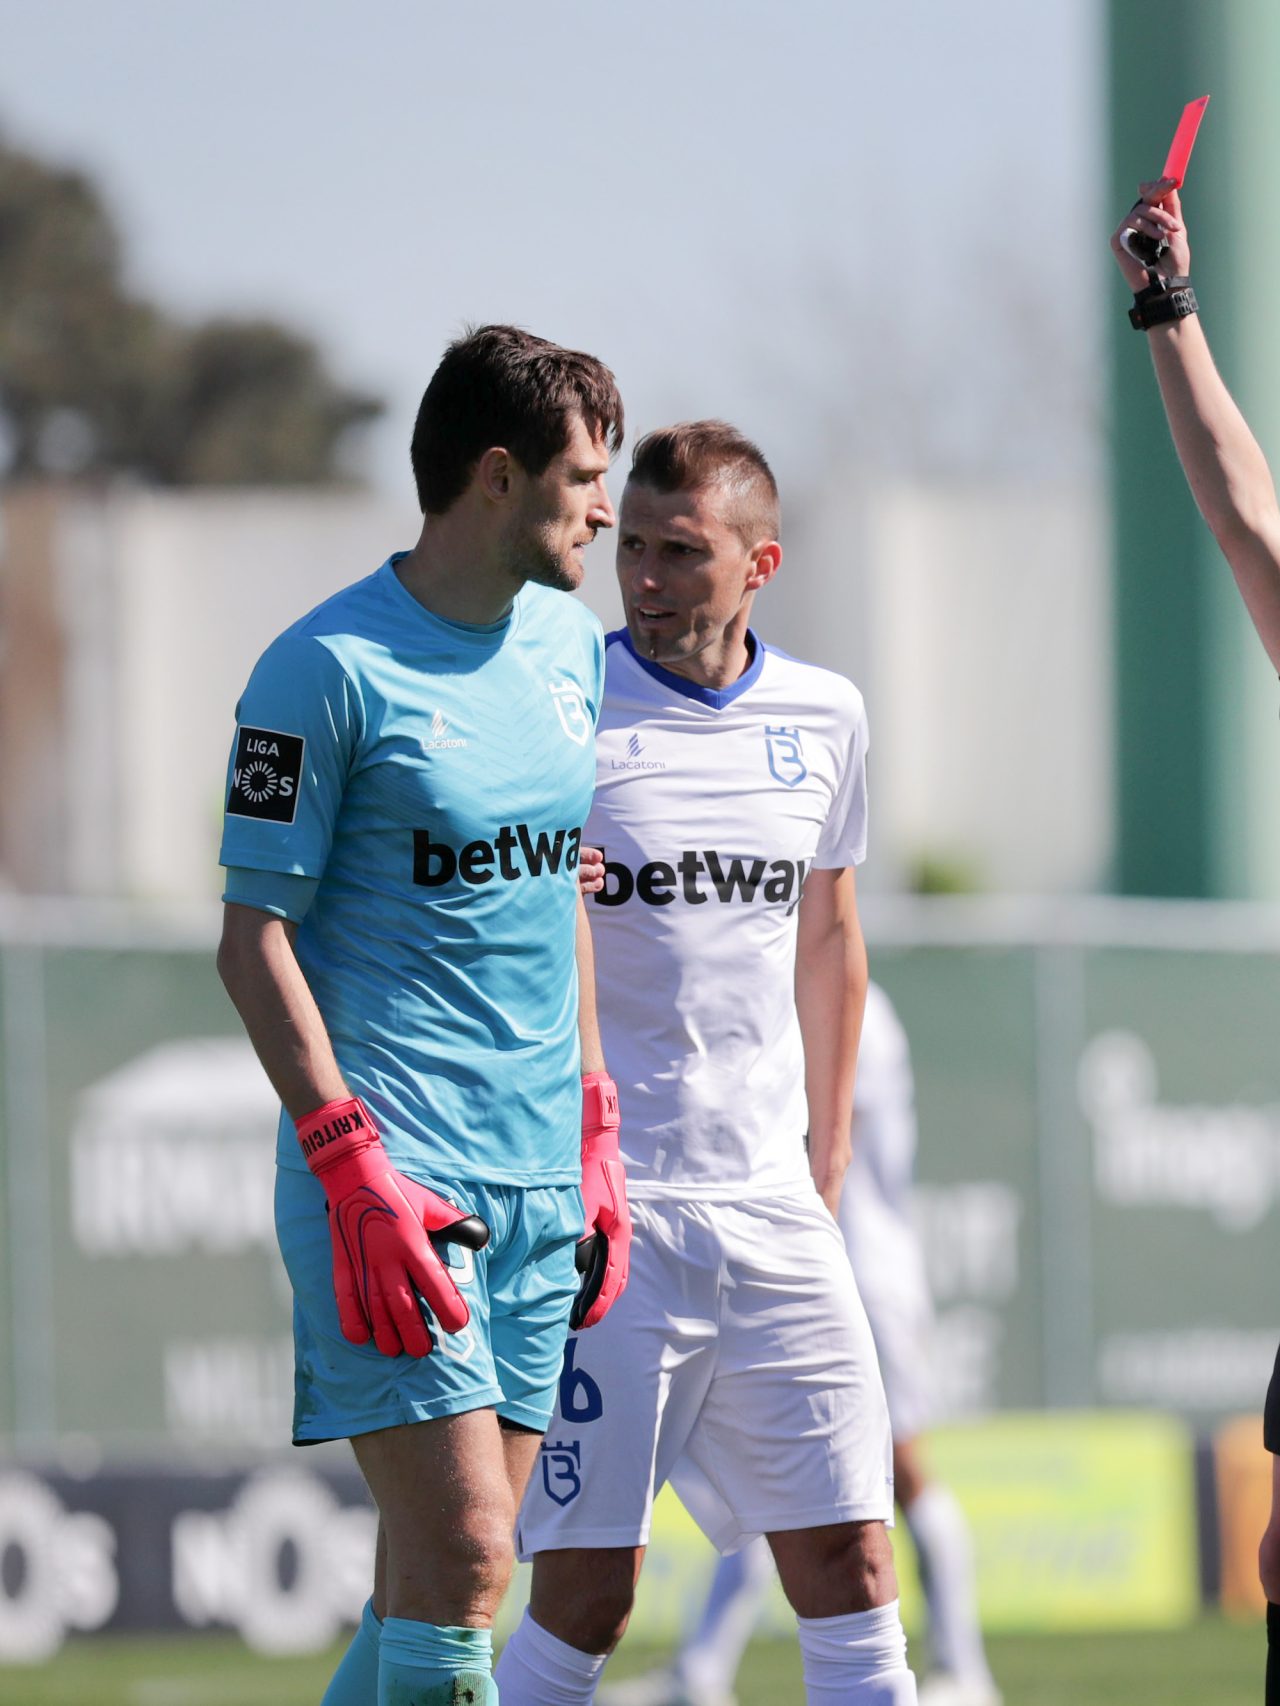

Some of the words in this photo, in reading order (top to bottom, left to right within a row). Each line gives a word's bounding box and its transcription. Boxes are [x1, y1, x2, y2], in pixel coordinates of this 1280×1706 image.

[246, 738, 280, 757] LIGA
[611, 759, 666, 770] Lacatoni
[412, 823, 582, 888] betwa
[301, 1111, 365, 1158] KRITCIU
[559, 1337, 603, 1424] 6
